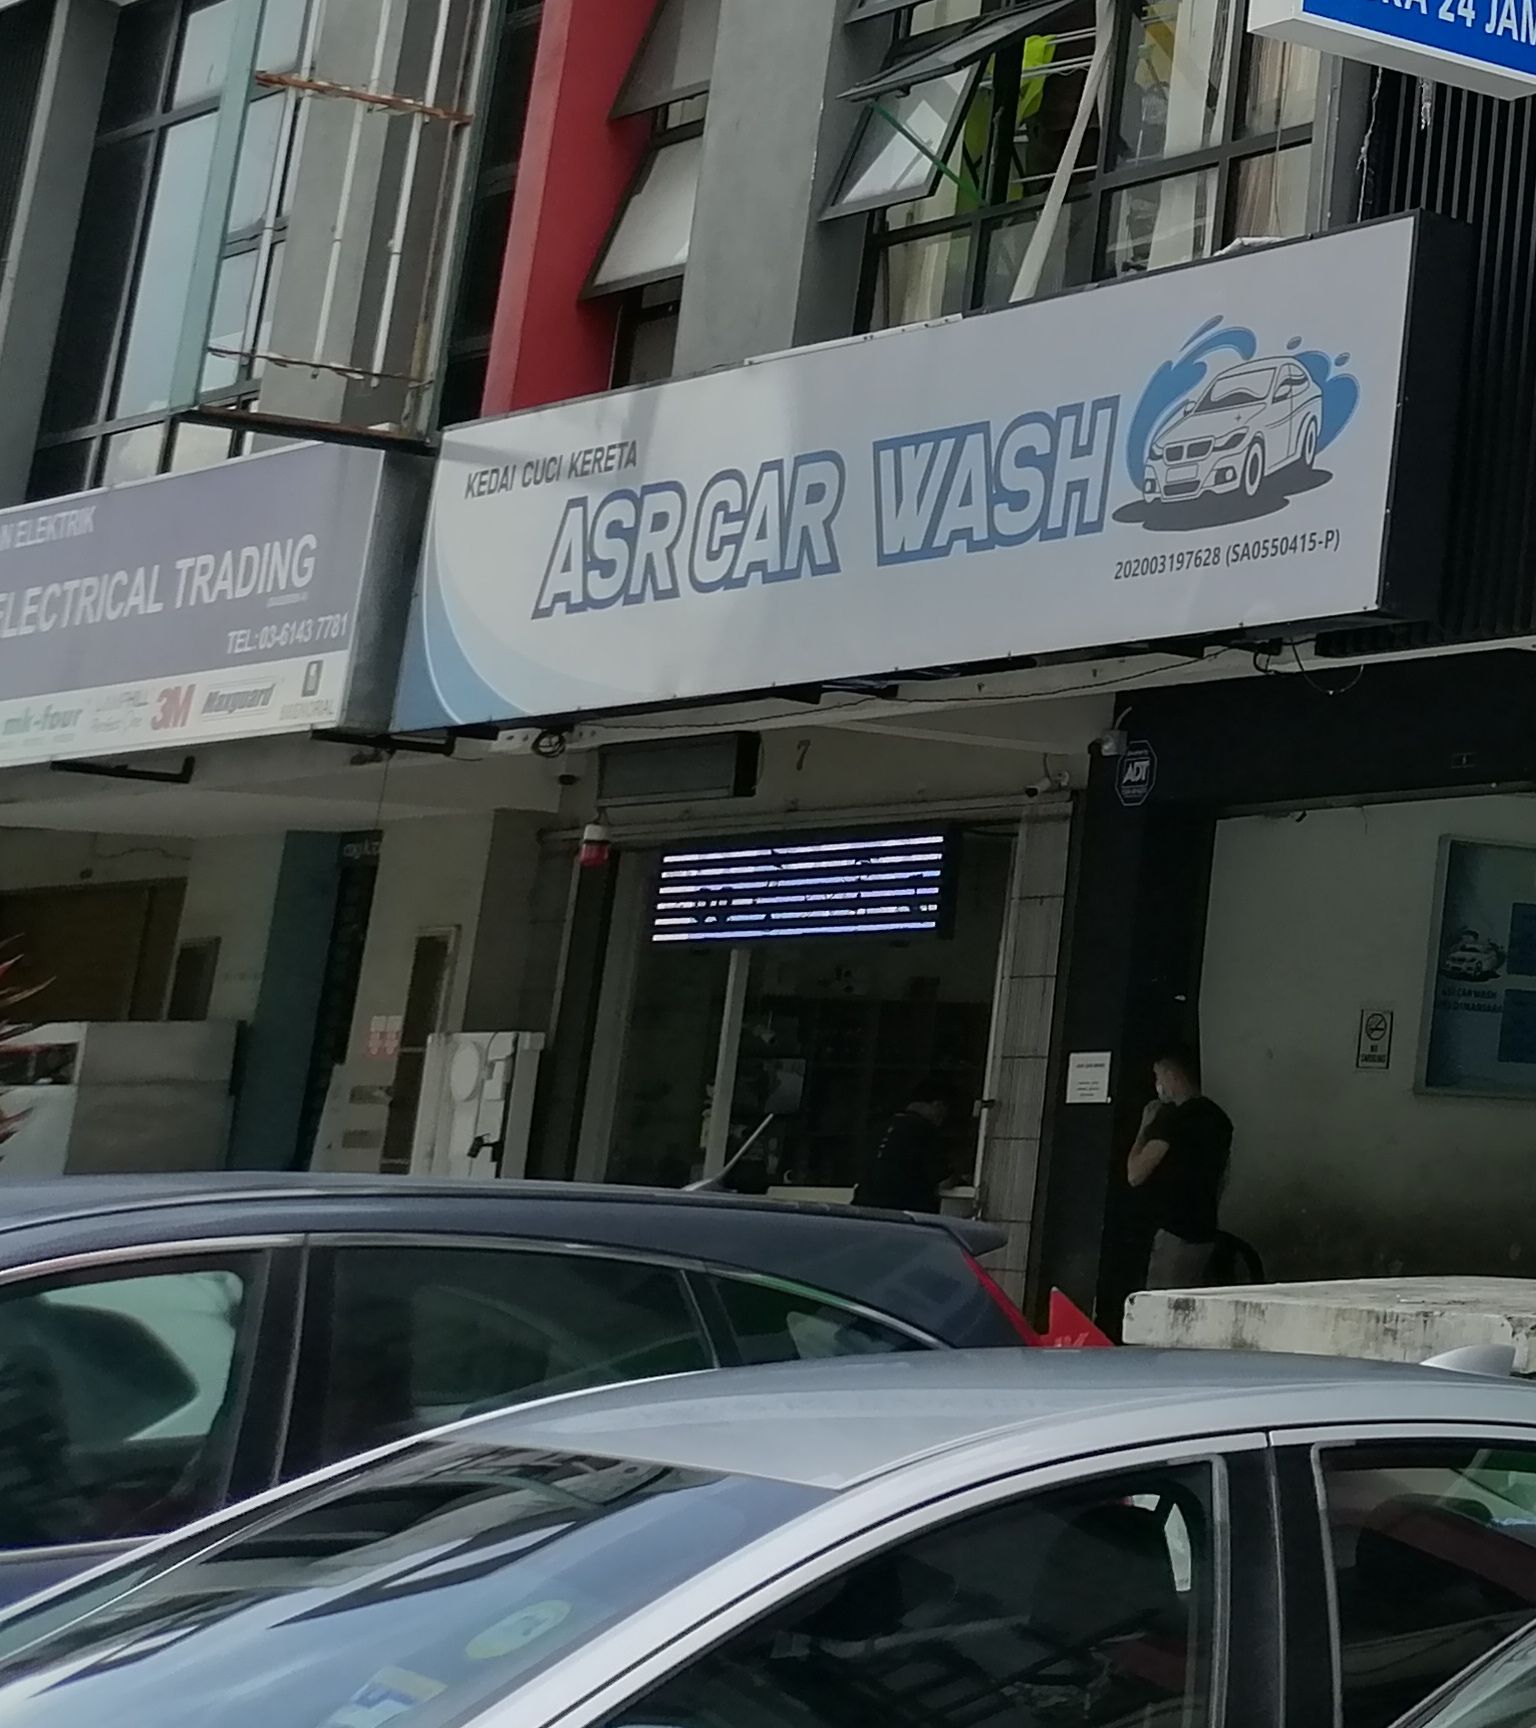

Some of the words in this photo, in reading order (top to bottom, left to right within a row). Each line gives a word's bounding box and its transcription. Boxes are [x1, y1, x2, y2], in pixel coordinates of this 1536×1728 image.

[464, 463, 516, 500] KEDAI
[520, 452, 564, 491] CUCI
[567, 437, 639, 481] KERETA
[531, 482, 686, 621] ASR
[689, 449, 846, 596] CAR
[872, 393, 1121, 568] WASH
[174, 533, 318, 610] TRADING
[1114, 545, 1221, 580] 202003197628
[1225, 528, 1341, 568] (SA0550415-P)
[150, 683, 197, 731] 3M
[1121, 760, 1151, 785] ADT
